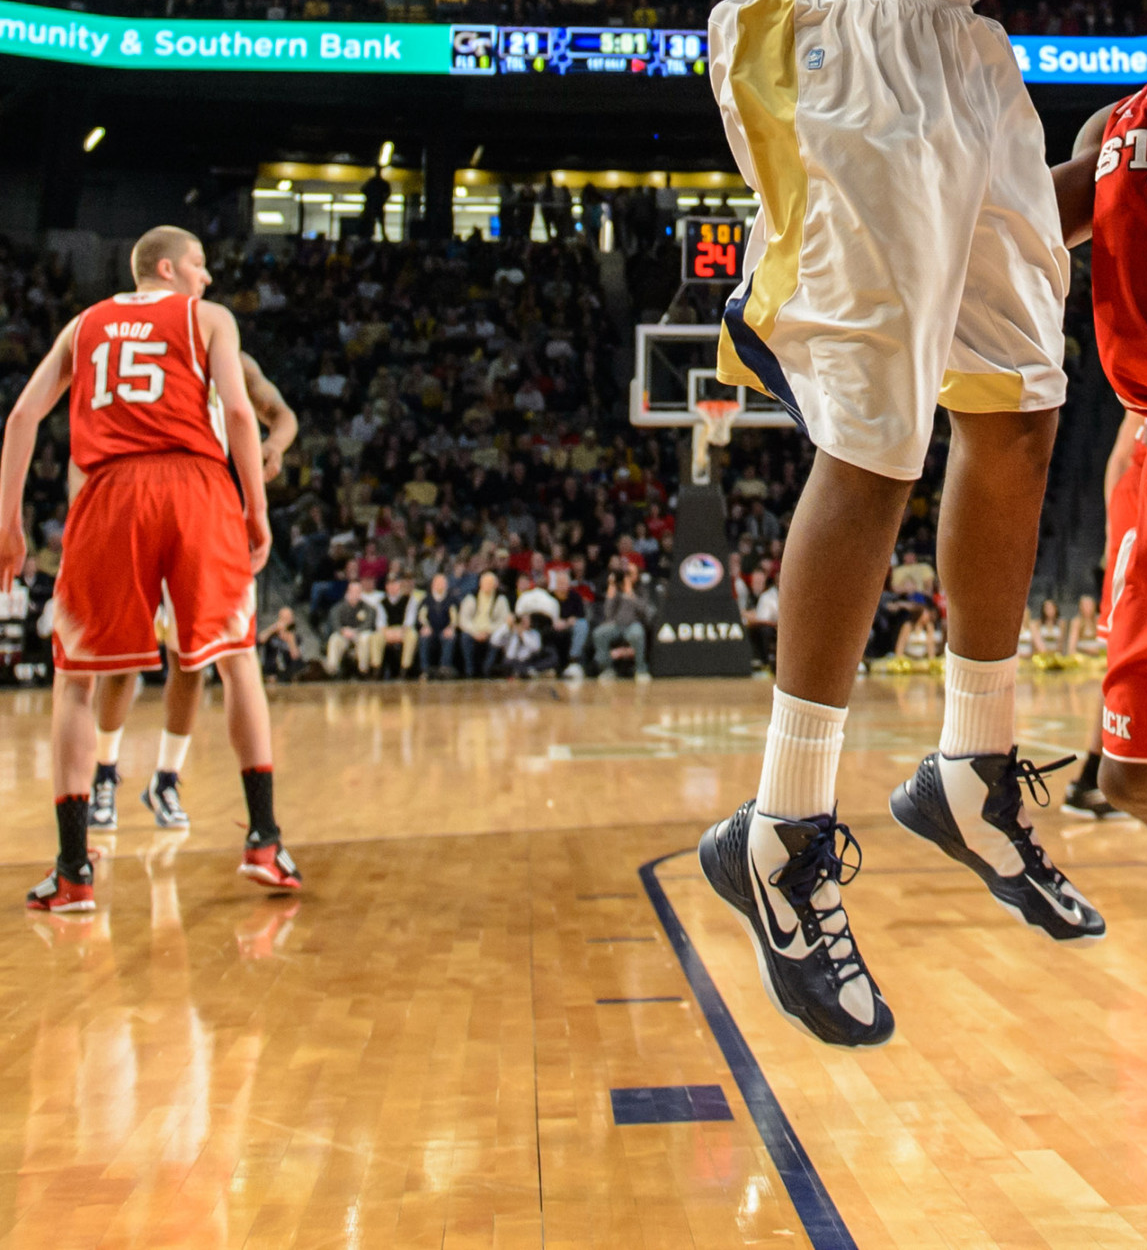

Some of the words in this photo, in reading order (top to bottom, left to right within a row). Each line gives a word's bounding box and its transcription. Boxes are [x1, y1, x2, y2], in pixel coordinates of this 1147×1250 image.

[120, 29, 142, 55] &
[154, 30, 307, 58] Southern
[319, 33, 402, 60] Bank
[510, 32, 538, 55] 21
[601, 32, 647, 54] 5:01
[670, 35, 700, 59] 30
[694, 241, 736, 278] 24
[104, 322, 153, 339] WOOD
[91, 341, 168, 410] 15
[678, 622, 744, 641] DELTA
